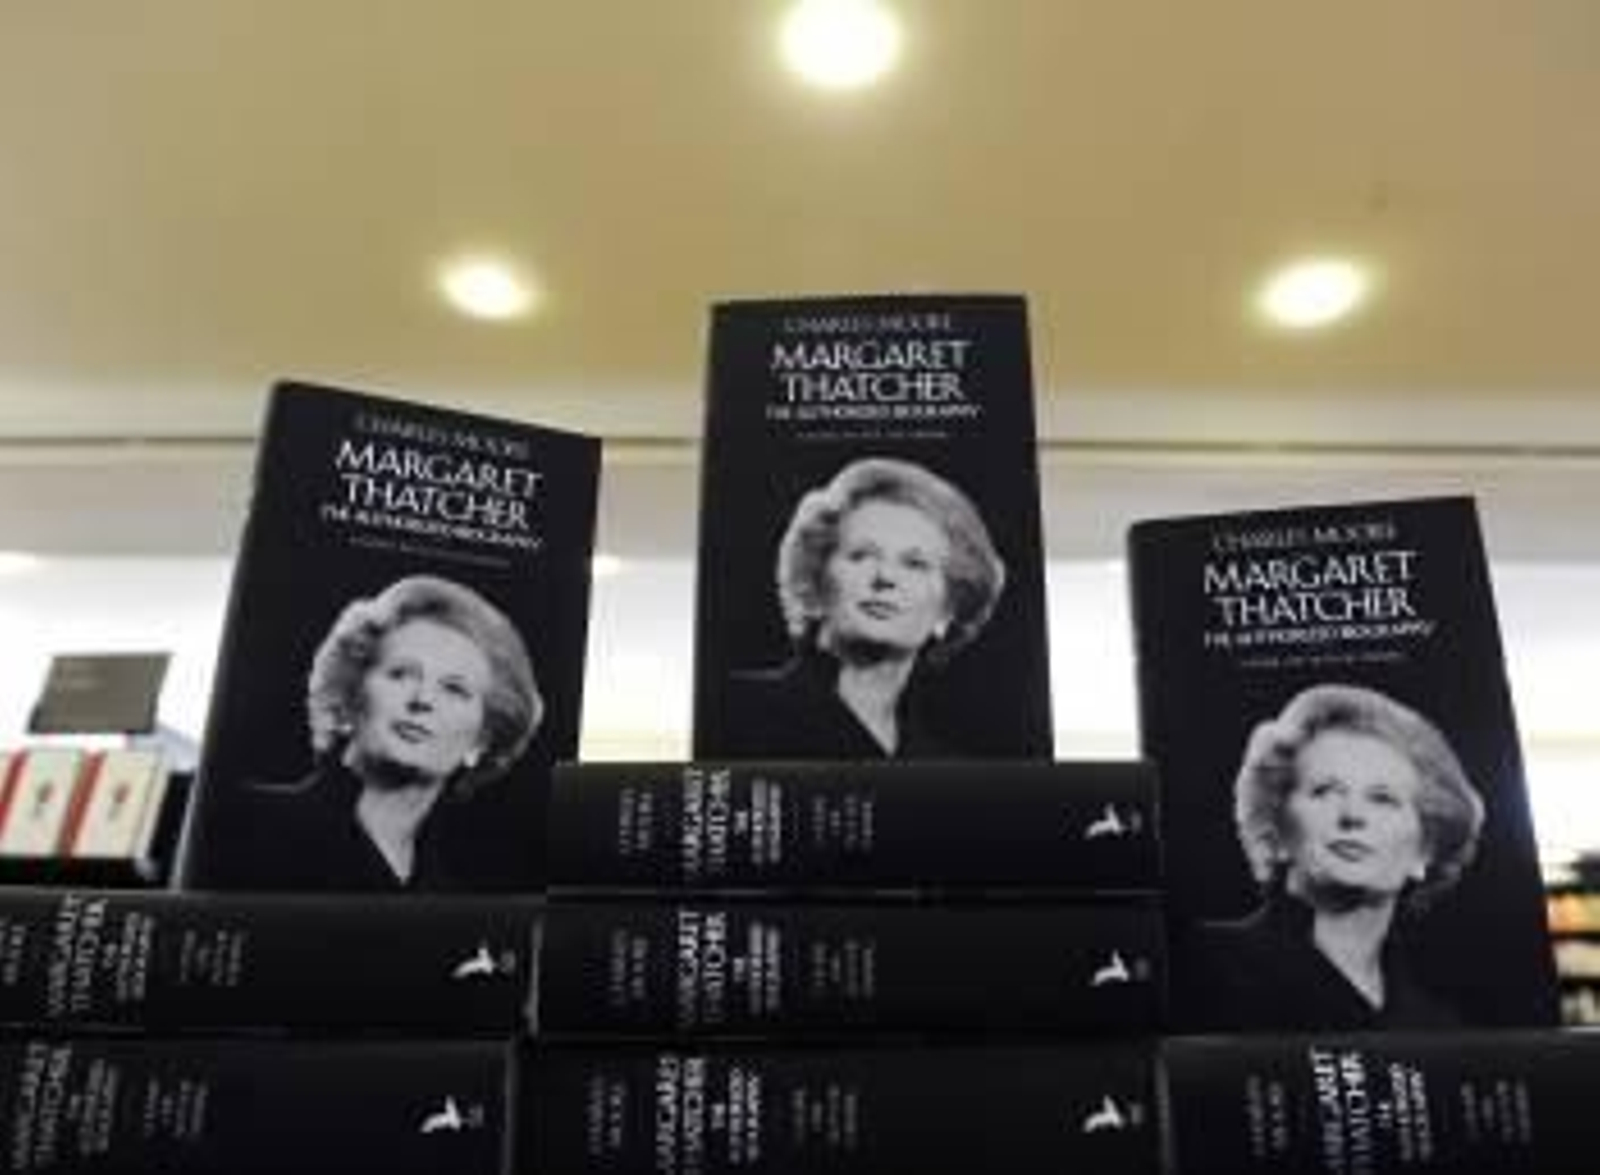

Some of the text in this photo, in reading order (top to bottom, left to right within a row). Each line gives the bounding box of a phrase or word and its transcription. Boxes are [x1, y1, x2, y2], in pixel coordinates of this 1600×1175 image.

[769, 339, 973, 370] MARGARET
[779, 373, 966, 403] THATCHER
[335, 439, 544, 498] MARGARET
[341, 472, 529, 530] THATCHER
[1204, 550, 1418, 595] MARGARET
[1212, 586, 1418, 627] THATCHER
